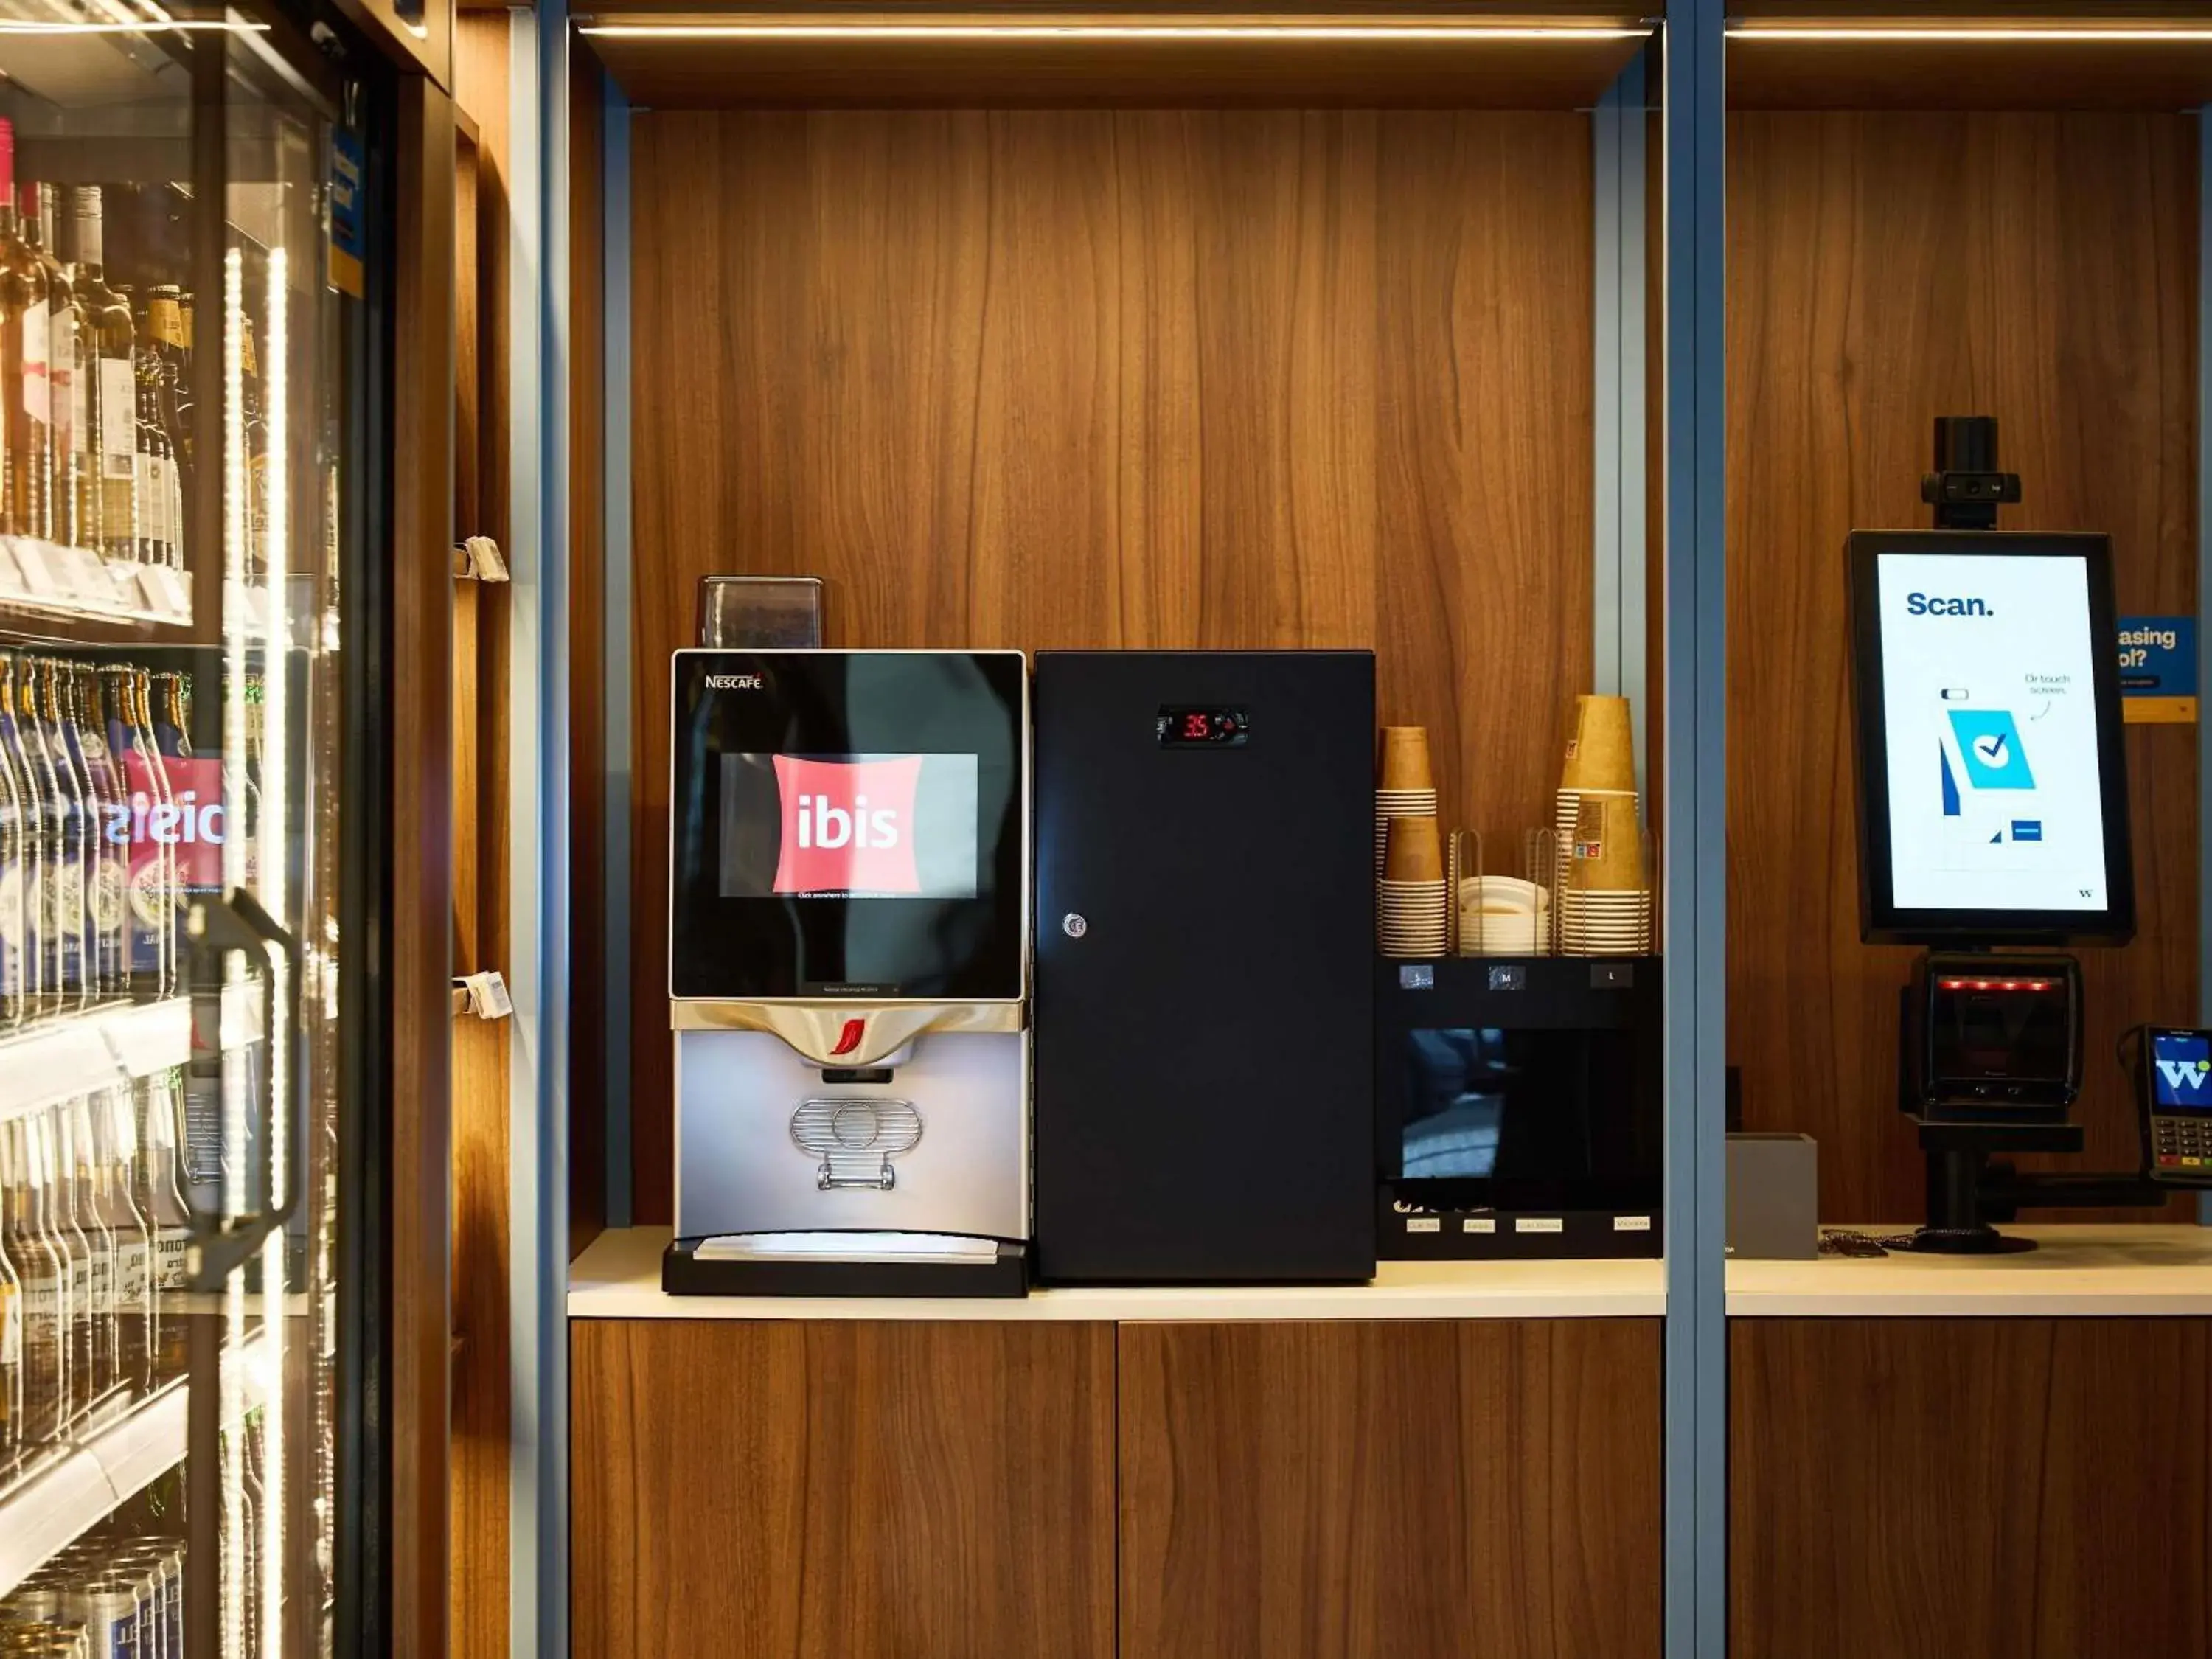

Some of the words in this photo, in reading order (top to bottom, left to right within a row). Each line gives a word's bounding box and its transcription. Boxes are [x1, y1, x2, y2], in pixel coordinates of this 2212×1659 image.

[1907, 592, 1994, 616] Scan.
[798, 795, 898, 849] ibis
[1502, 973, 1512, 982] M
[1608, 971, 1614, 980] L
